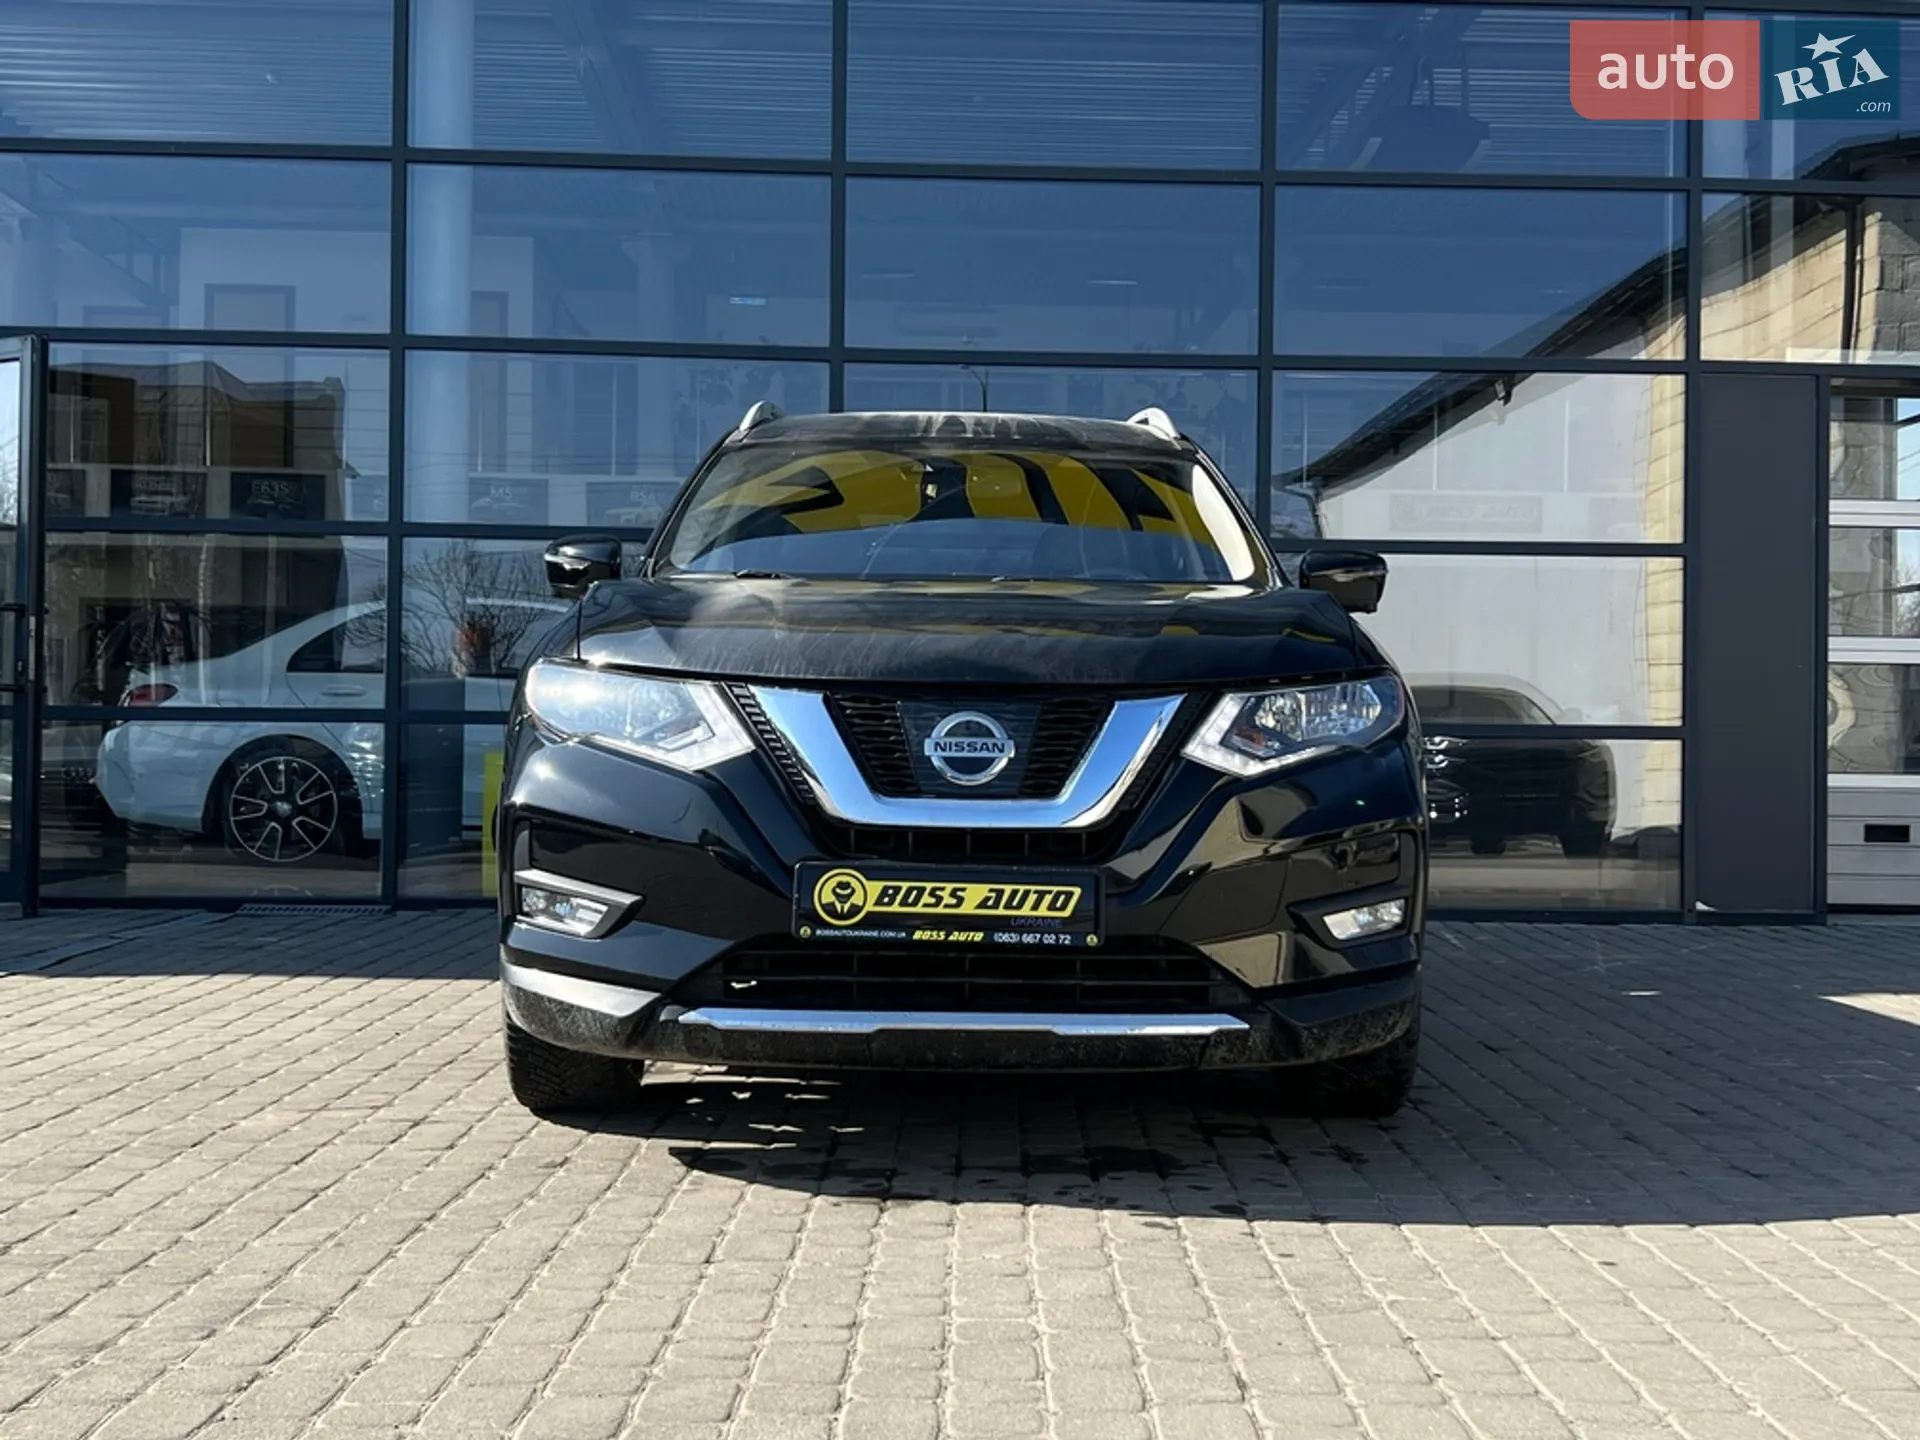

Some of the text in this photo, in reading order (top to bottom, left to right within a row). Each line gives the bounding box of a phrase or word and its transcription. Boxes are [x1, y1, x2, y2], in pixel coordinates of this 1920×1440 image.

[934, 741, 1005, 753] NISSAN
[873, 885, 1077, 912] BOSS AUTO
[1010, 917, 1062, 928] UKRAINE
[912, 930, 946, 940] BOSS
[947, 931, 984, 942] AUTO
[1021, 933, 1042, 944] 667
[1042, 934, 1056, 944] 02
[1057, 934, 1072, 945] 72
